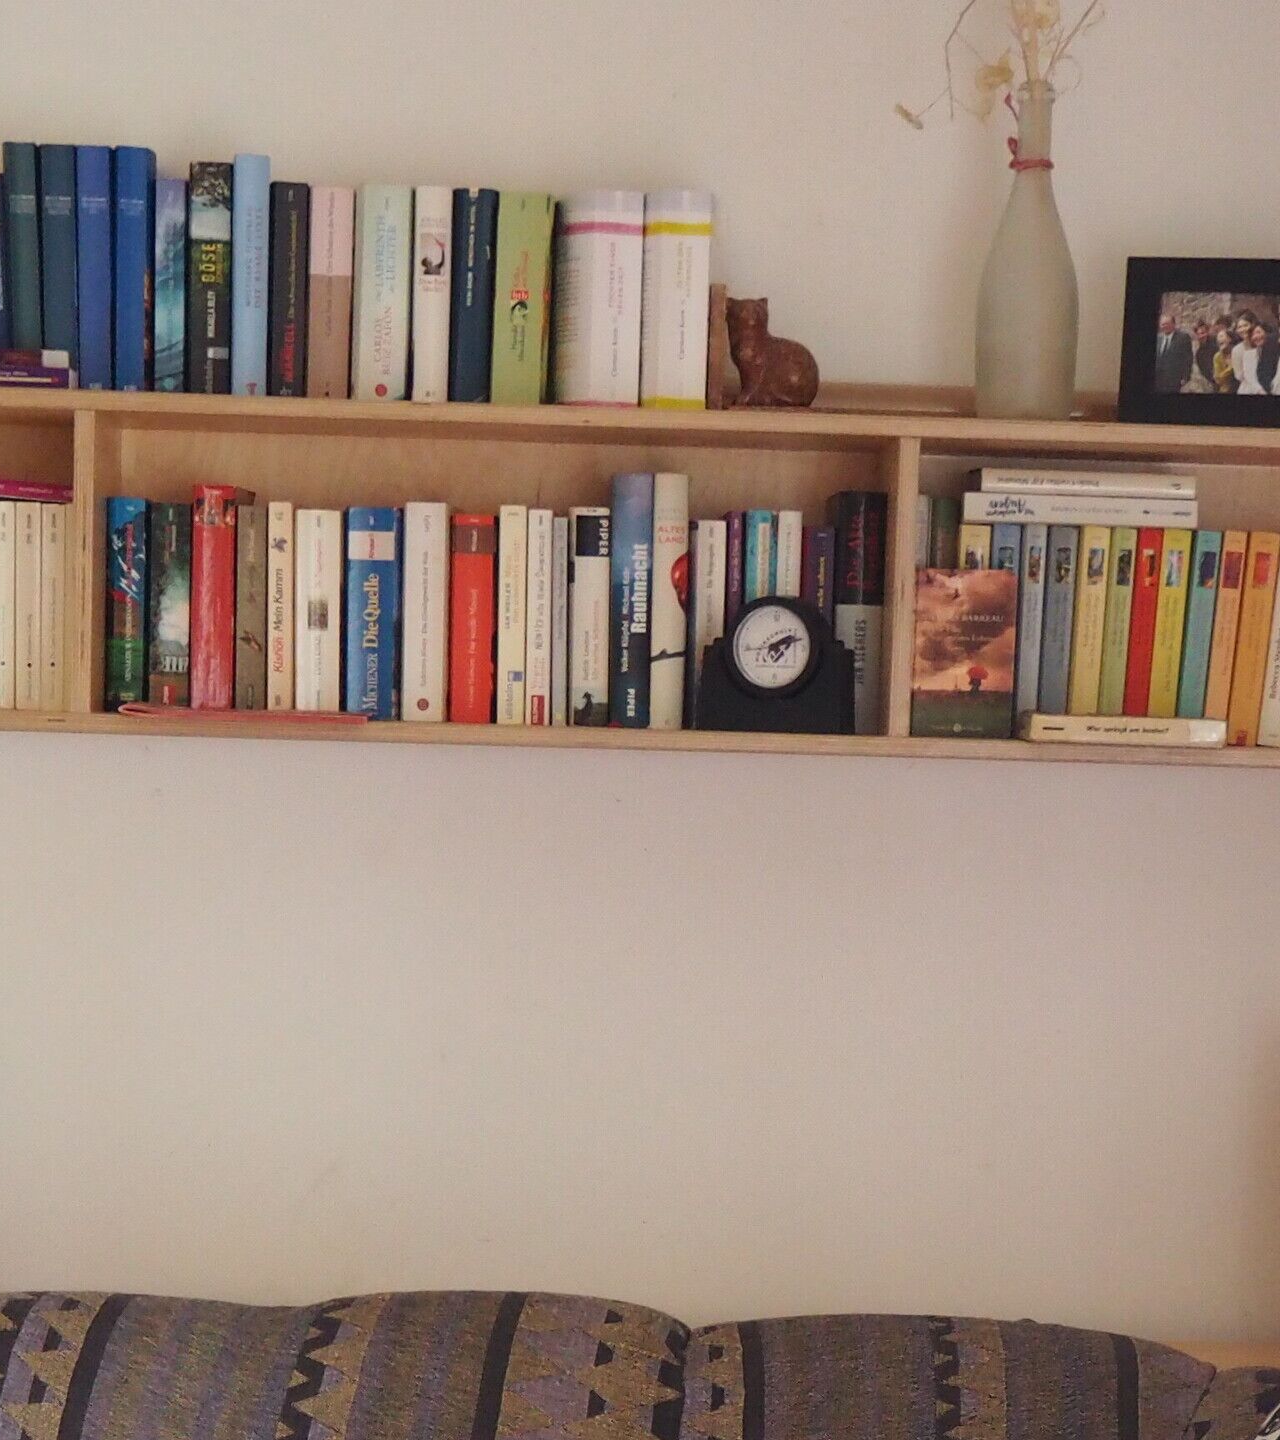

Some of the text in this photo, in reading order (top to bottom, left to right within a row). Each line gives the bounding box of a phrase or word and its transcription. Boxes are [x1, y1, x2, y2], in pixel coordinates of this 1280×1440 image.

[198, 243, 216, 283] BÖSE
[598, 519, 609, 556] PIPER
[658, 535, 686, 544] LAND
[630, 543, 648, 634] Rauhnacht
[272, 568, 284, 674] Kishon Mein Kamm
[361, 573, 380, 710] MICHENER Die Quelle
[505, 682, 514, 720] ullstein
[1268, 664, 1280, 700] Rebecca
[626, 688, 636, 717] PIPER
